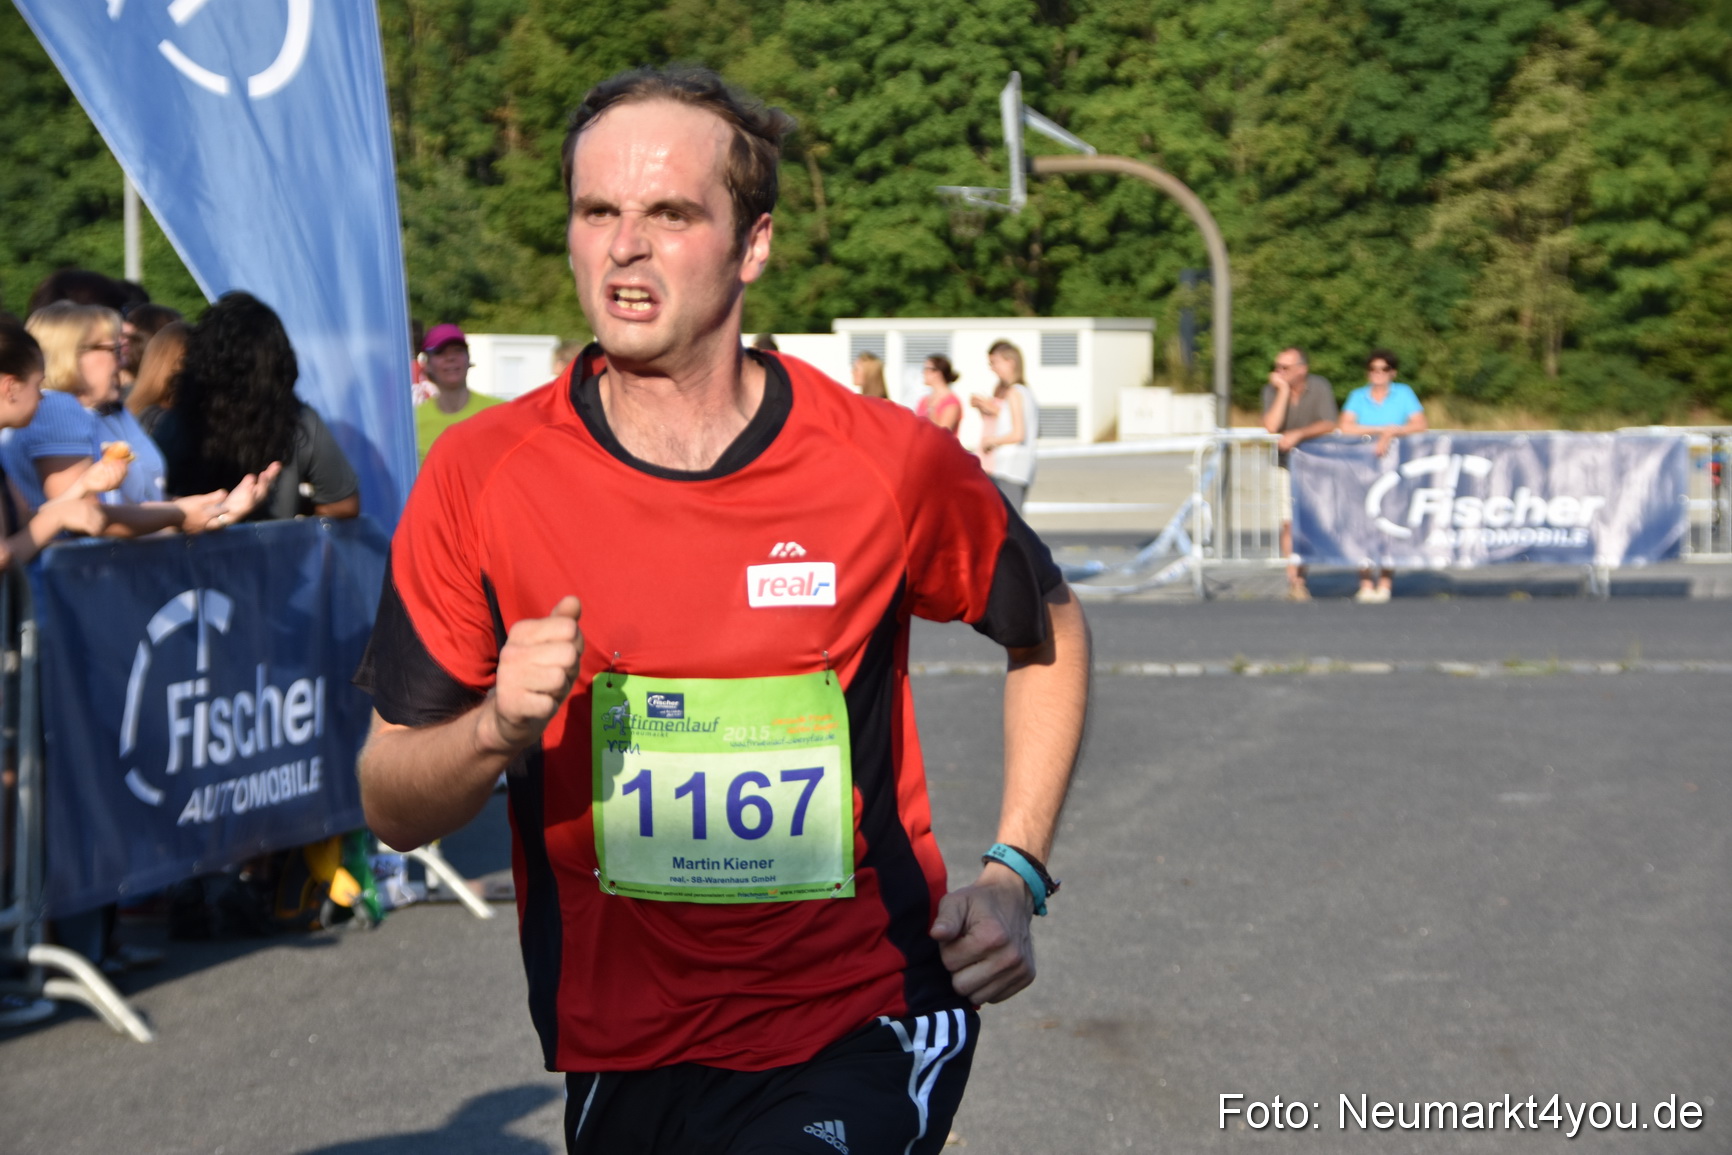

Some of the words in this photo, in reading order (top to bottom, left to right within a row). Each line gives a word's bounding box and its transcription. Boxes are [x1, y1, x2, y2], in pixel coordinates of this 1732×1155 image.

[1408, 486, 1605, 529] Fischer
[1427, 527, 1590, 547] AUTOMOBILE
[631, 714, 720, 733] firmenlauf
[723, 725, 771, 742] 2015
[176, 756, 323, 826] AUTOMOBILE
[622, 766, 825, 841] 1167
[672, 857, 720, 870] Martin
[724, 858, 775, 870] Kiener
[751, 875, 776, 884] GmbH
[803, 1125, 849, 1155] adidas
